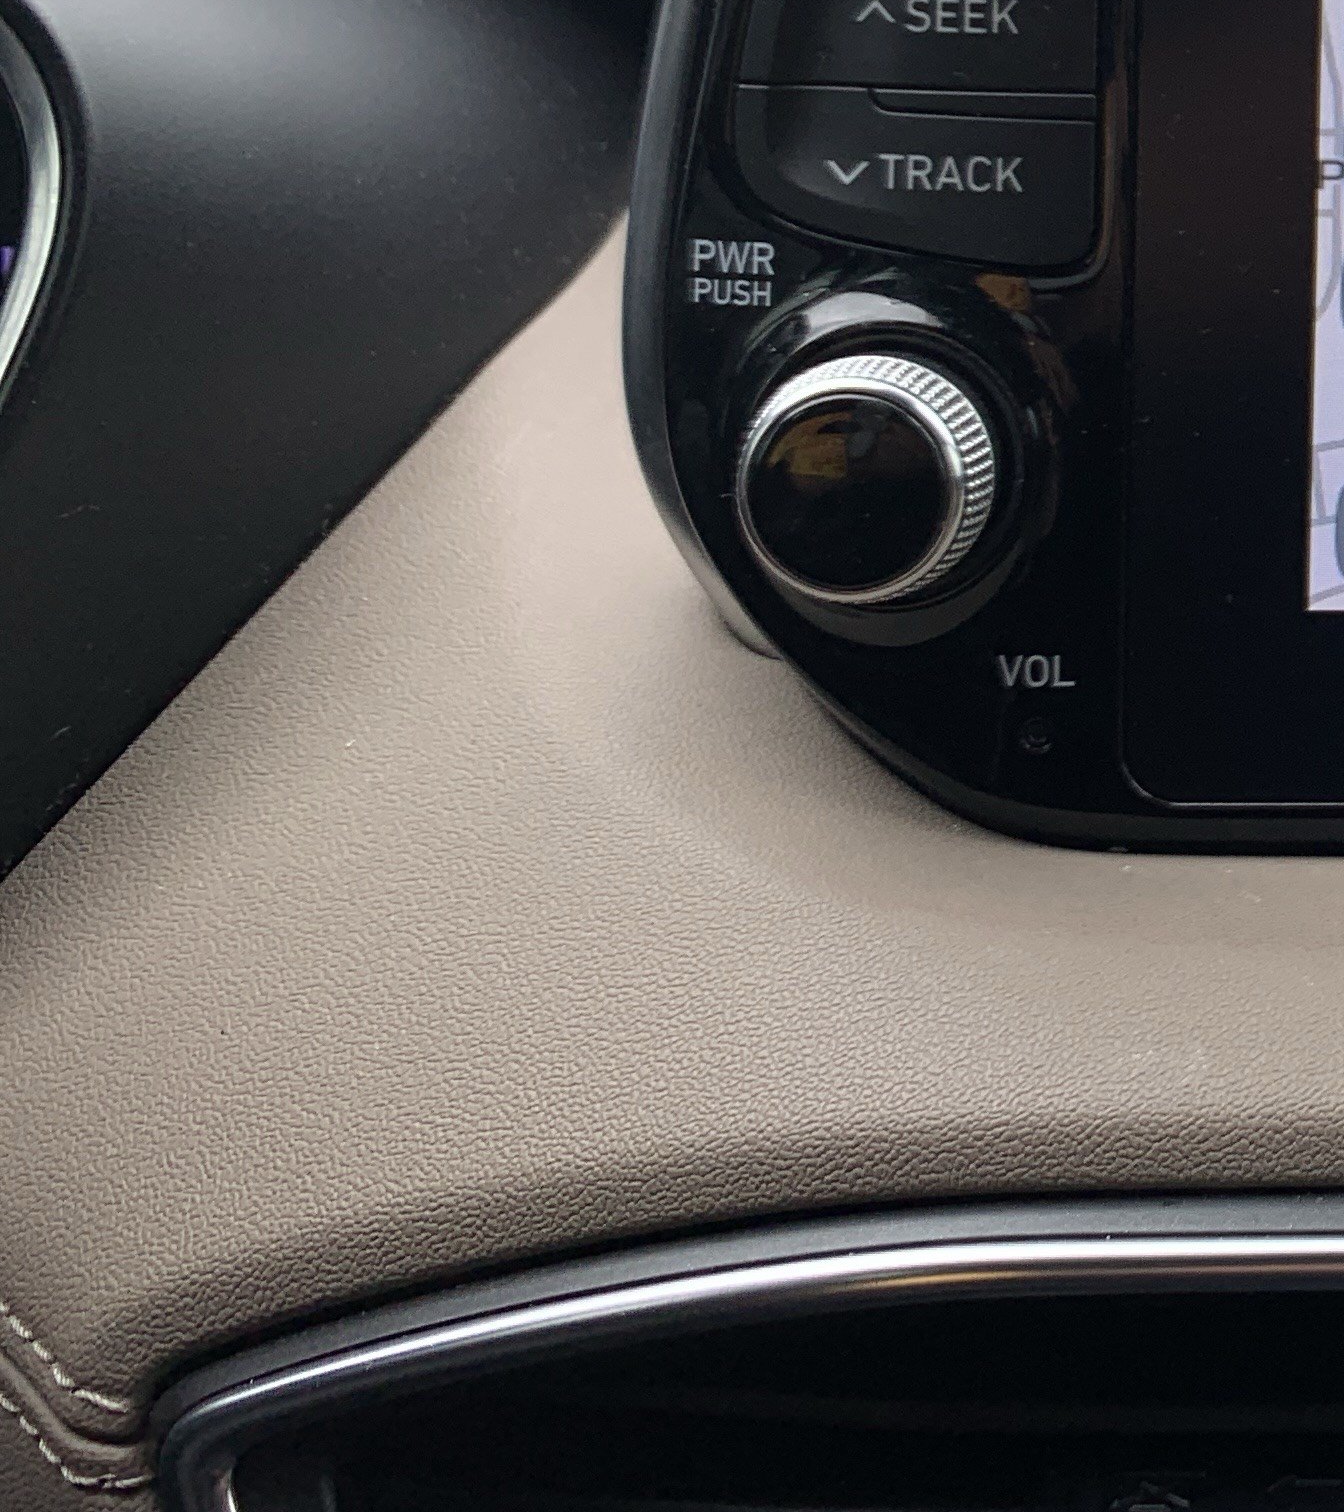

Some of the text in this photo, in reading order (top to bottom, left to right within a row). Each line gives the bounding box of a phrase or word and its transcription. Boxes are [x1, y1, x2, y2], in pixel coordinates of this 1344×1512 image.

[878, 153, 1025, 193] TRACK
[690, 239, 776, 276] PWR
[690, 277, 772, 307] PUSH
[998, 654, 1076, 688] VOL
